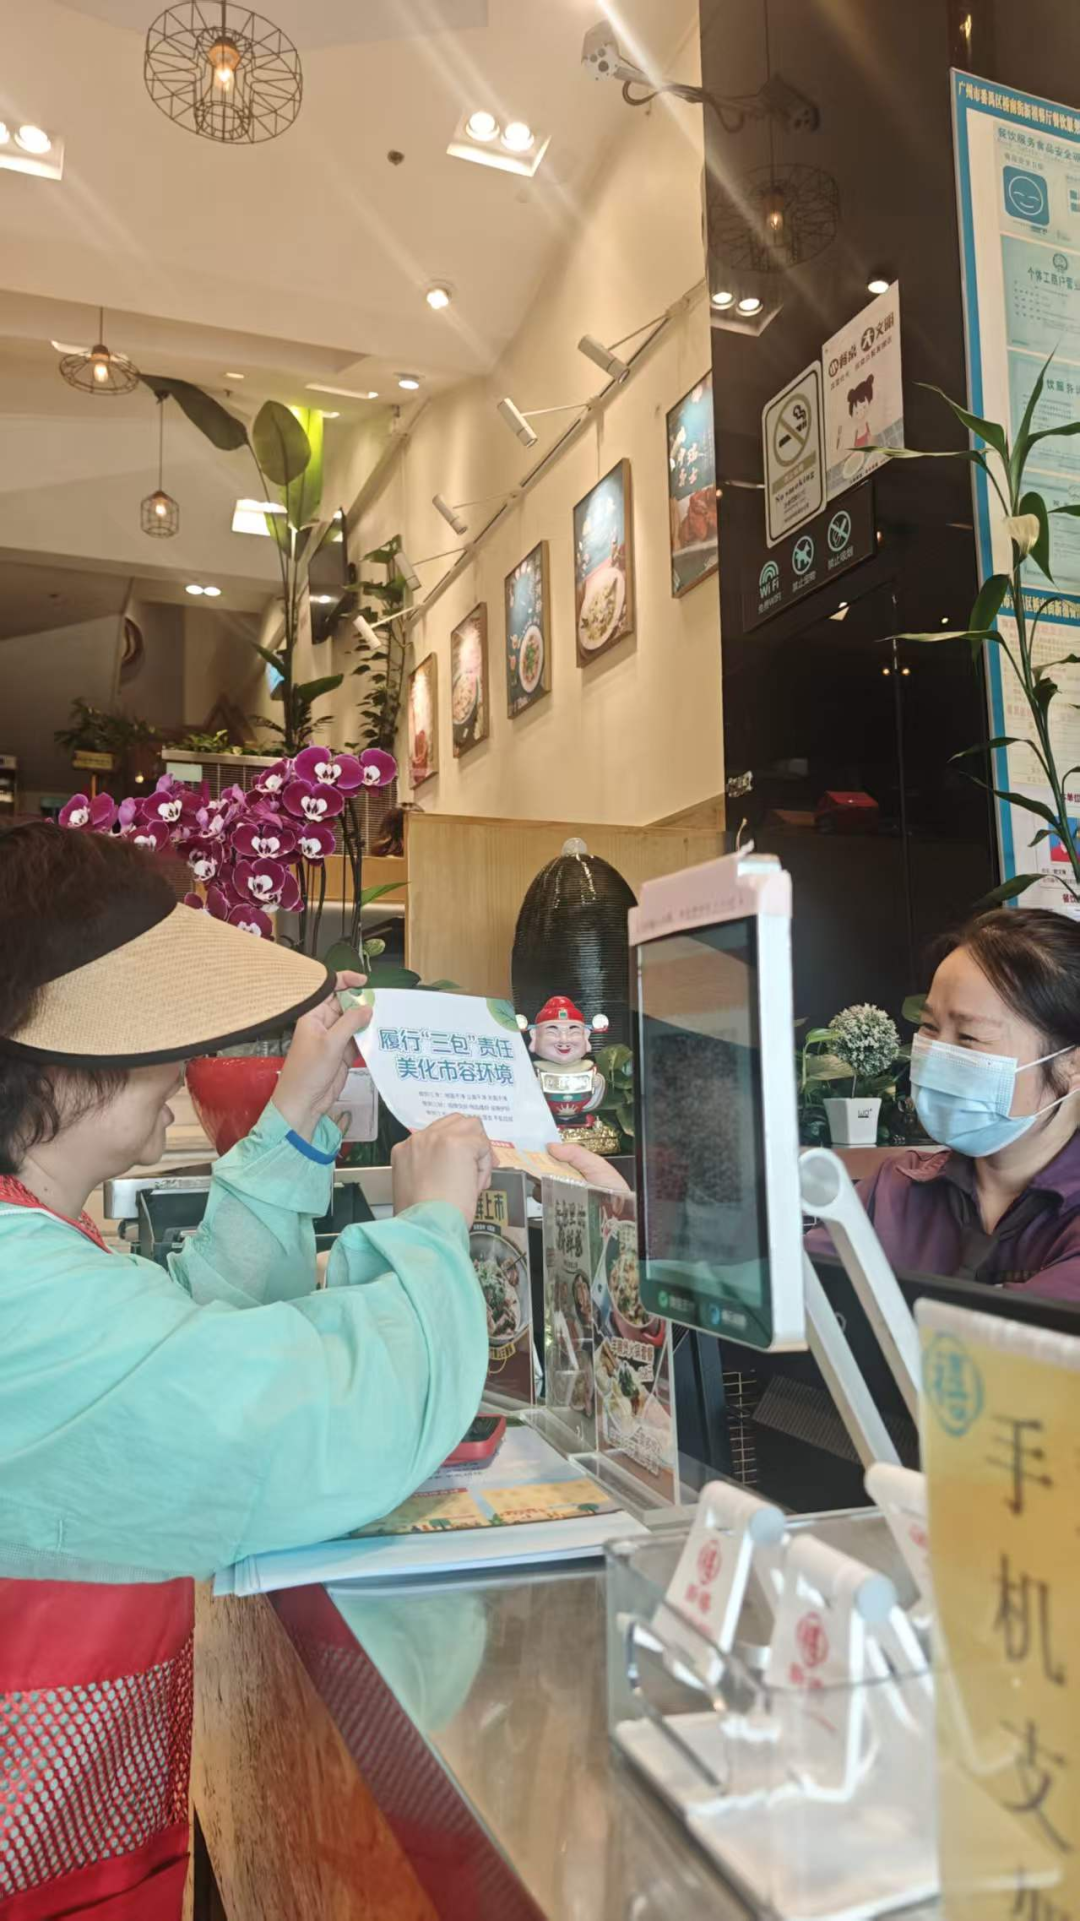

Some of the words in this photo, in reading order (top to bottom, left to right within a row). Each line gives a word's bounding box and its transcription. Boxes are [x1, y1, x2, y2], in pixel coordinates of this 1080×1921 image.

[380, 1029, 514, 1059] 履行“三包”责任
[399, 1057, 514, 1085] 美化市容环境
